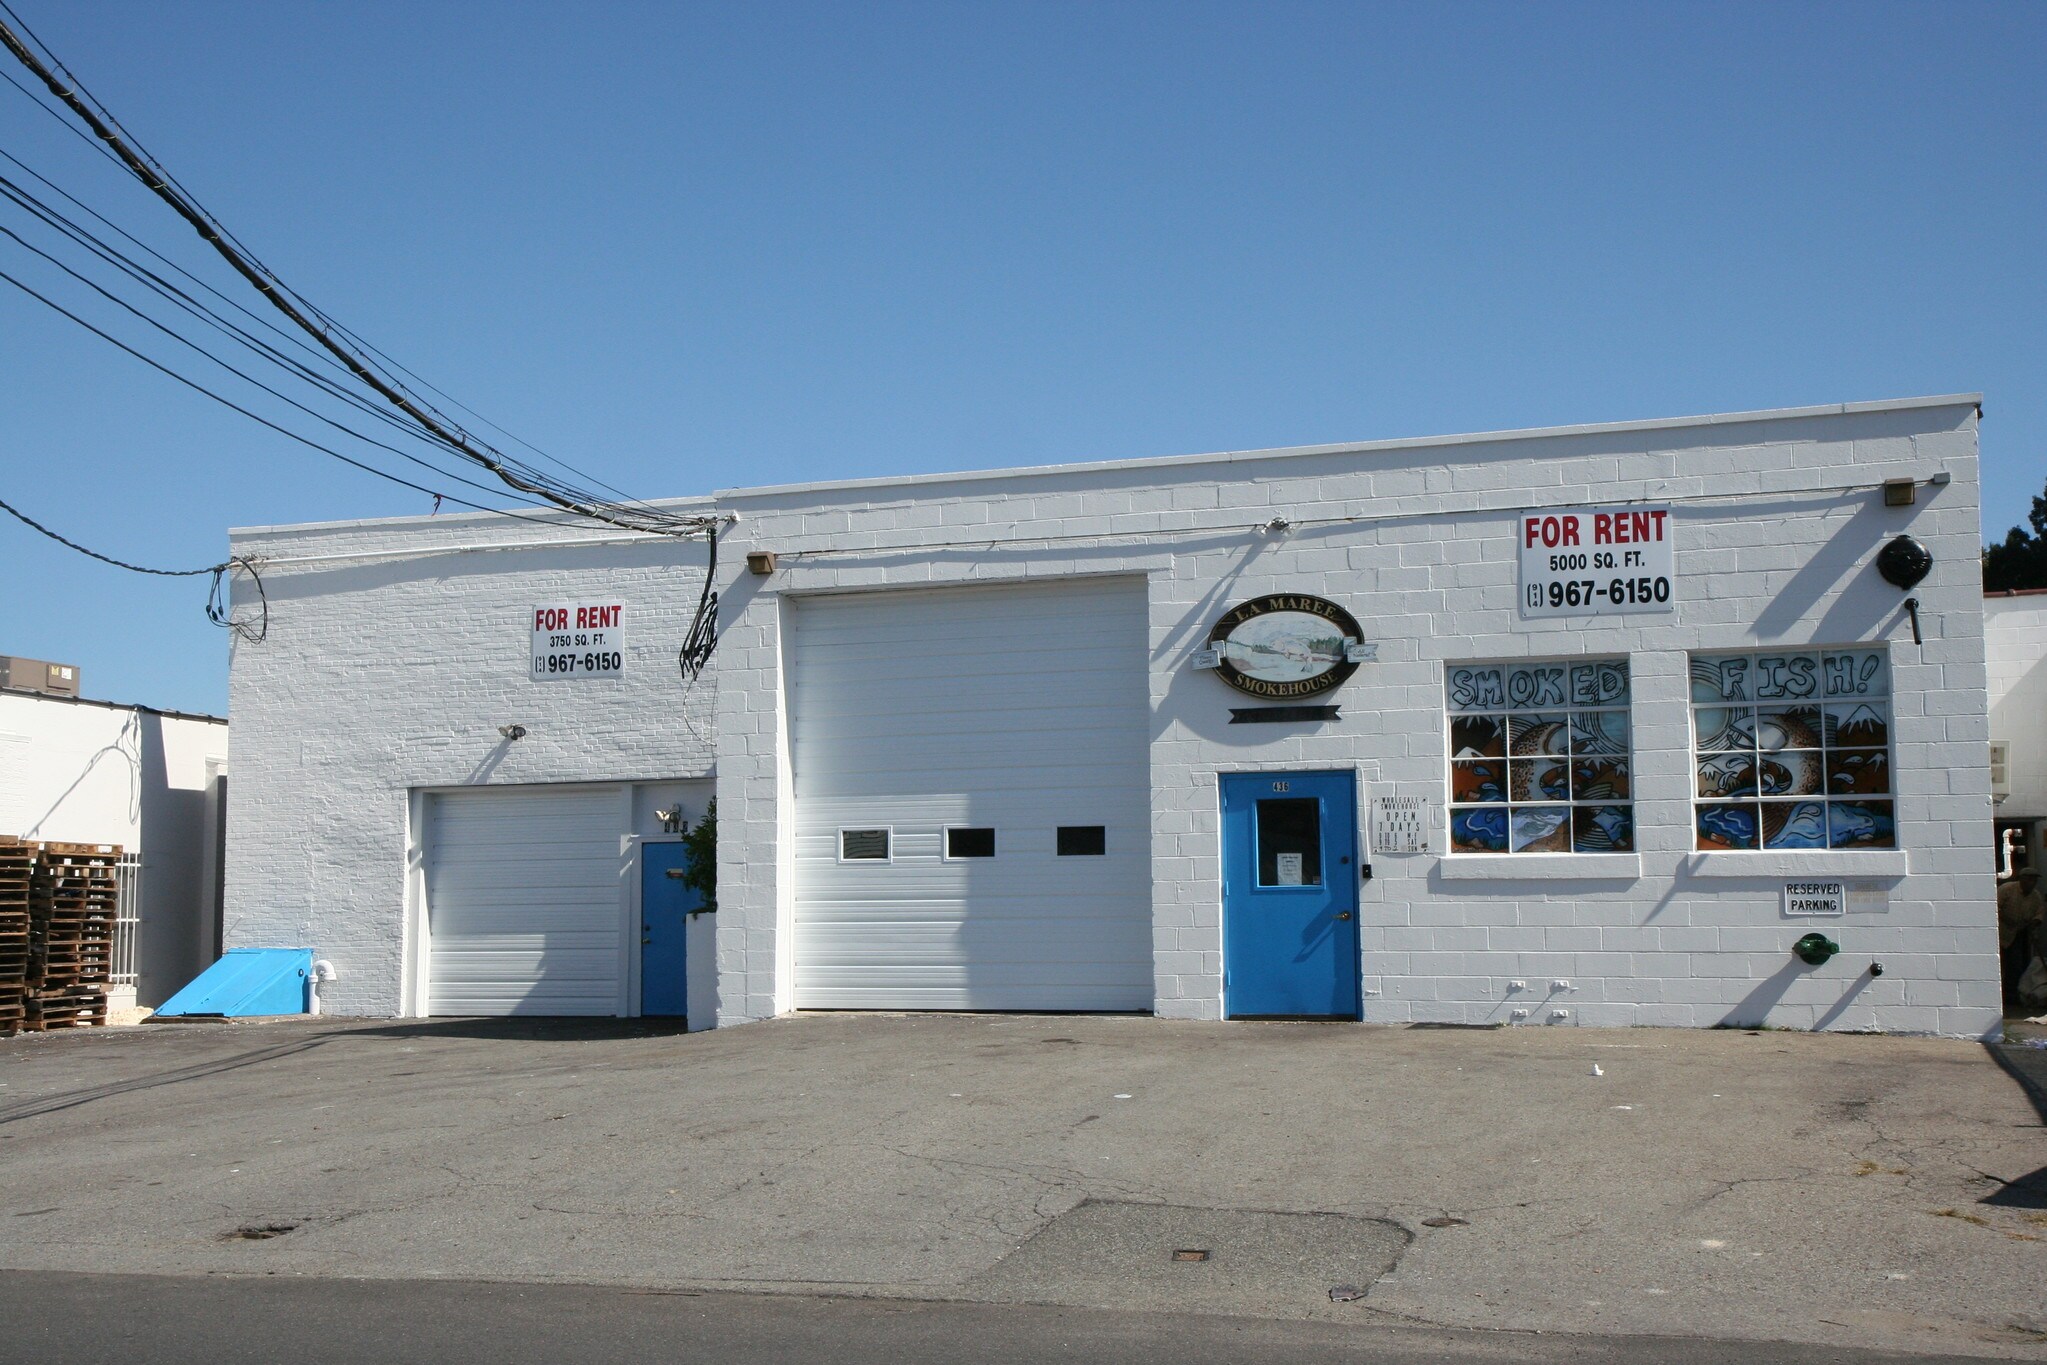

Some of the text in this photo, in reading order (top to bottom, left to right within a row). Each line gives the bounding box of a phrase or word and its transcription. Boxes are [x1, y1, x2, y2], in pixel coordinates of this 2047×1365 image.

[1526, 510, 1668, 549] FOR RENT
[1550, 551, 1645, 571] 5000 SQ. FT.
[1549, 576, 1670, 607] 967-6150
[535, 605, 621, 631] FOR RENT
[1234, 597, 1336, 622] LA MAREE
[550, 633, 606, 647] 3750 SQ. FT.
[548, 651, 621, 673] 967-6150
[1234, 670, 1338, 696] SMOKEHOUSE
[1452, 664, 1625, 706] SMOKED
[1719, 654, 1879, 698] FISH!
[1386, 812, 1416, 821] OPEN
[1391, 822, 1420, 831] DAYS
[1786, 884, 1840, 895] RESERVED
[1791, 900, 1837, 911] PARKING
